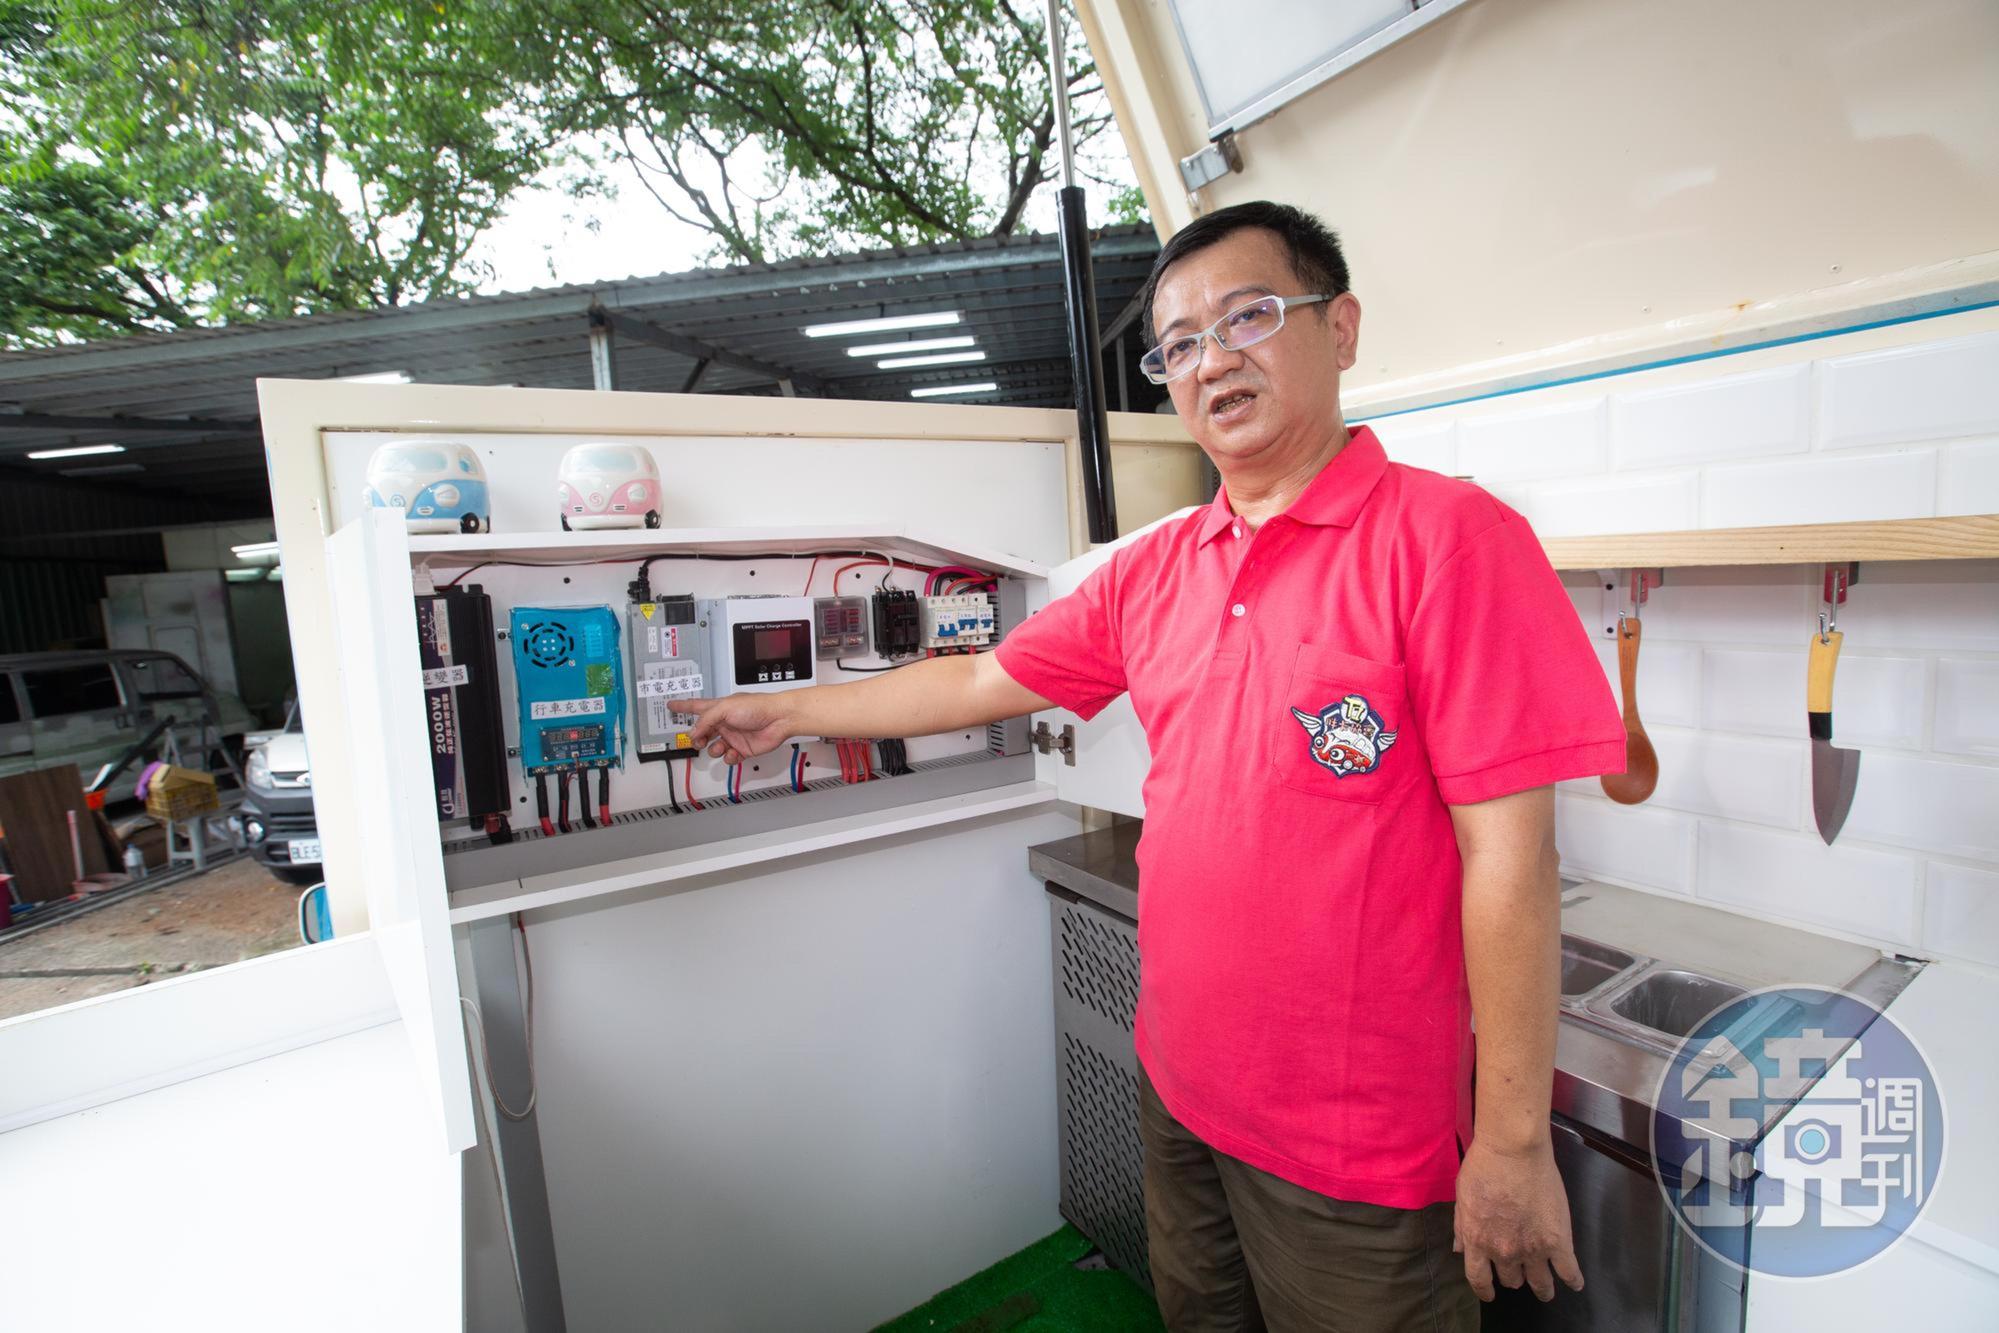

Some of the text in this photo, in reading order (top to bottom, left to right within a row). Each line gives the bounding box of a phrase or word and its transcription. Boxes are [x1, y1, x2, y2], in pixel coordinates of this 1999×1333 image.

[640, 676, 702, 695] 市電充電器
[534, 699, 604, 716] 行車充電器
[431, 696, 447, 754] 2000W
